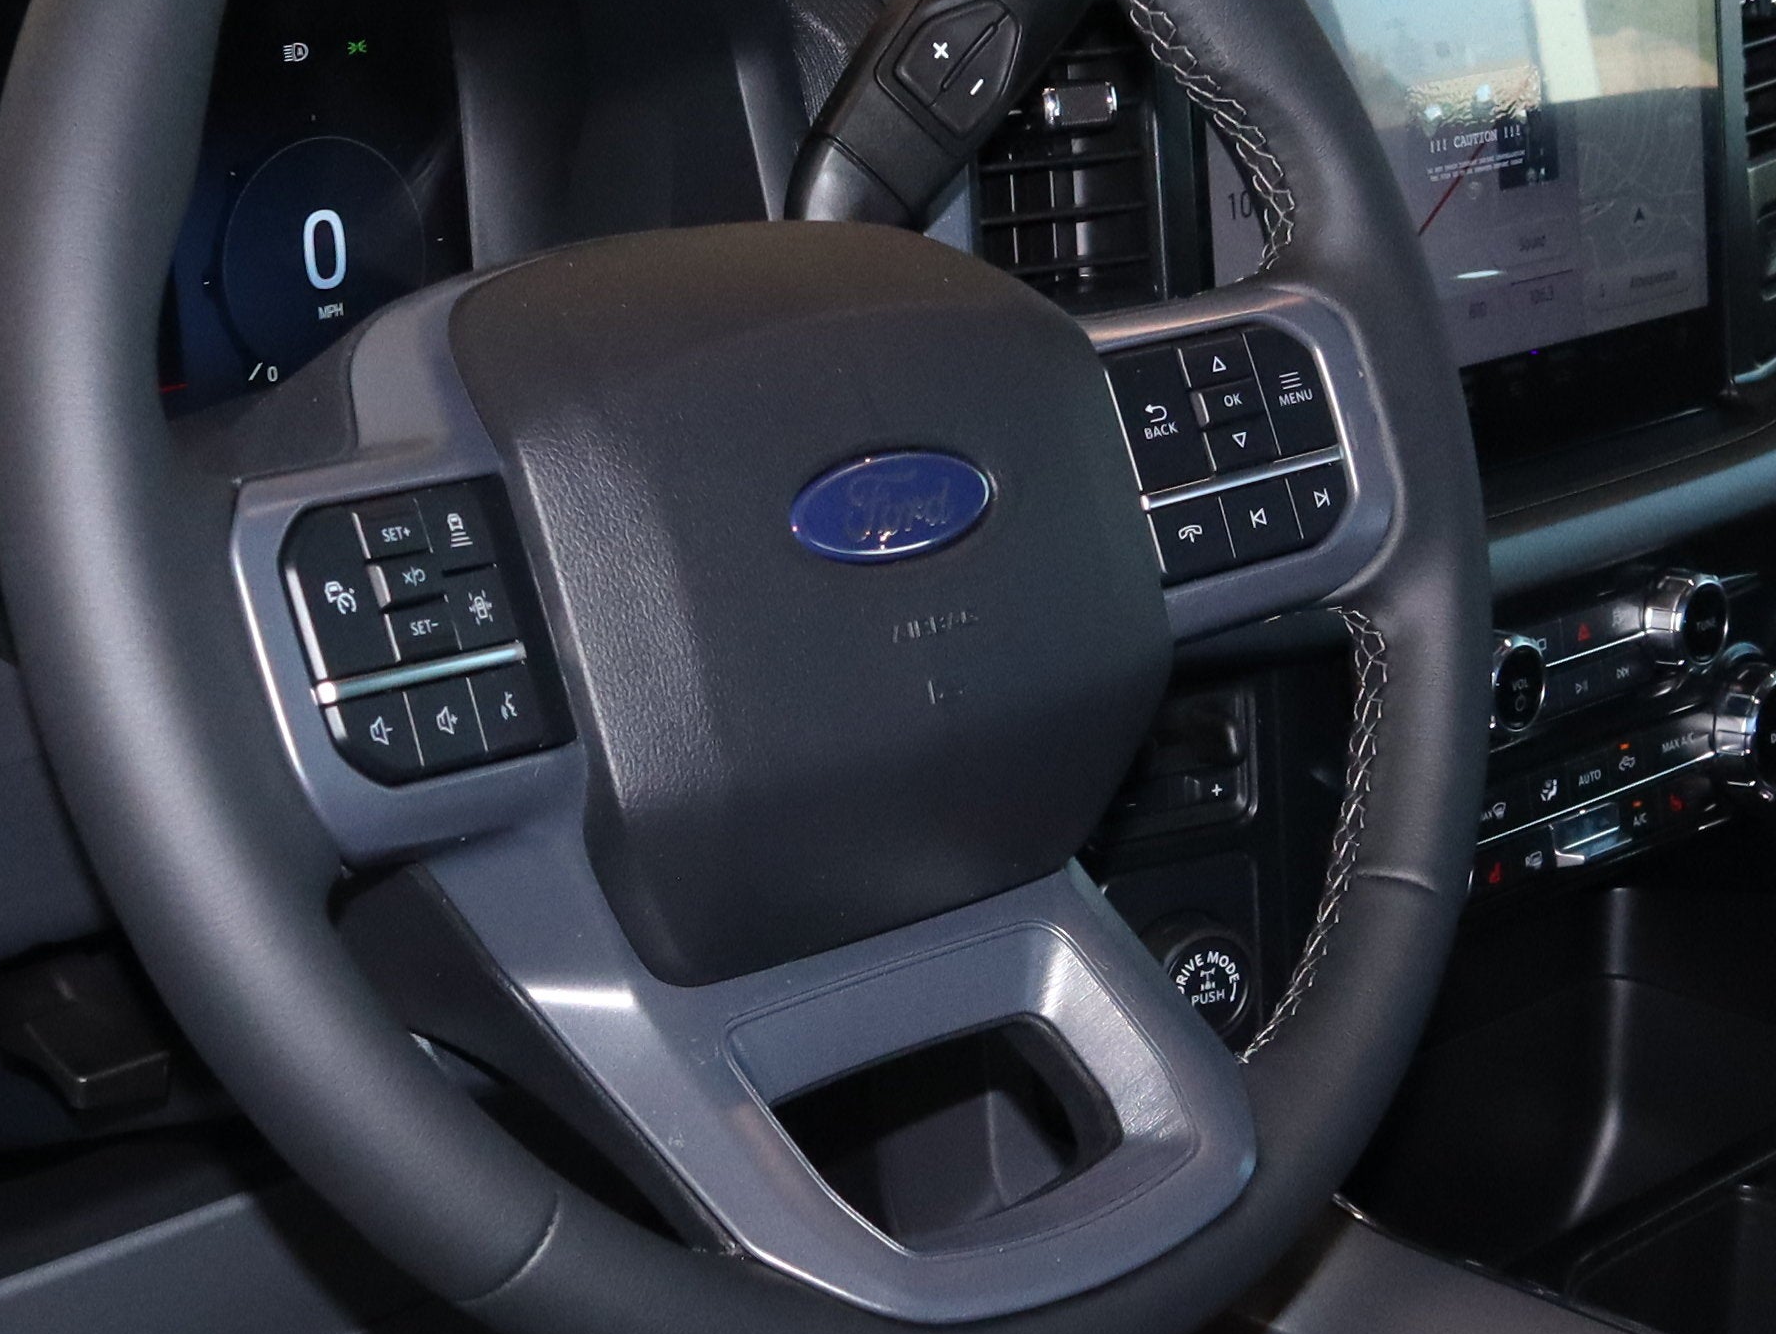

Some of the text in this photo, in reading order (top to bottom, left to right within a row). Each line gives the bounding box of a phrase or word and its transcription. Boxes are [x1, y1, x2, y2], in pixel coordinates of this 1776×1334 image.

[1453, 128, 1498, 149] CAUTION
[303, 208, 347, 290] 0
[318, 302, 344, 320] MPH
[1224, 392, 1243, 408] OK
[1278, 388, 1314, 407] MENU
[1143, 421, 1180, 440] BACK
[381, 525, 412, 543] SET+
[1511, 677, 1529, 692] VOL
[1577, 768, 1602, 788] AUTO
[1632, 810, 1648, 828] A/C
[1206, 950, 1241, 985] MODE
[1190, 988, 1227, 1007] PUSH
